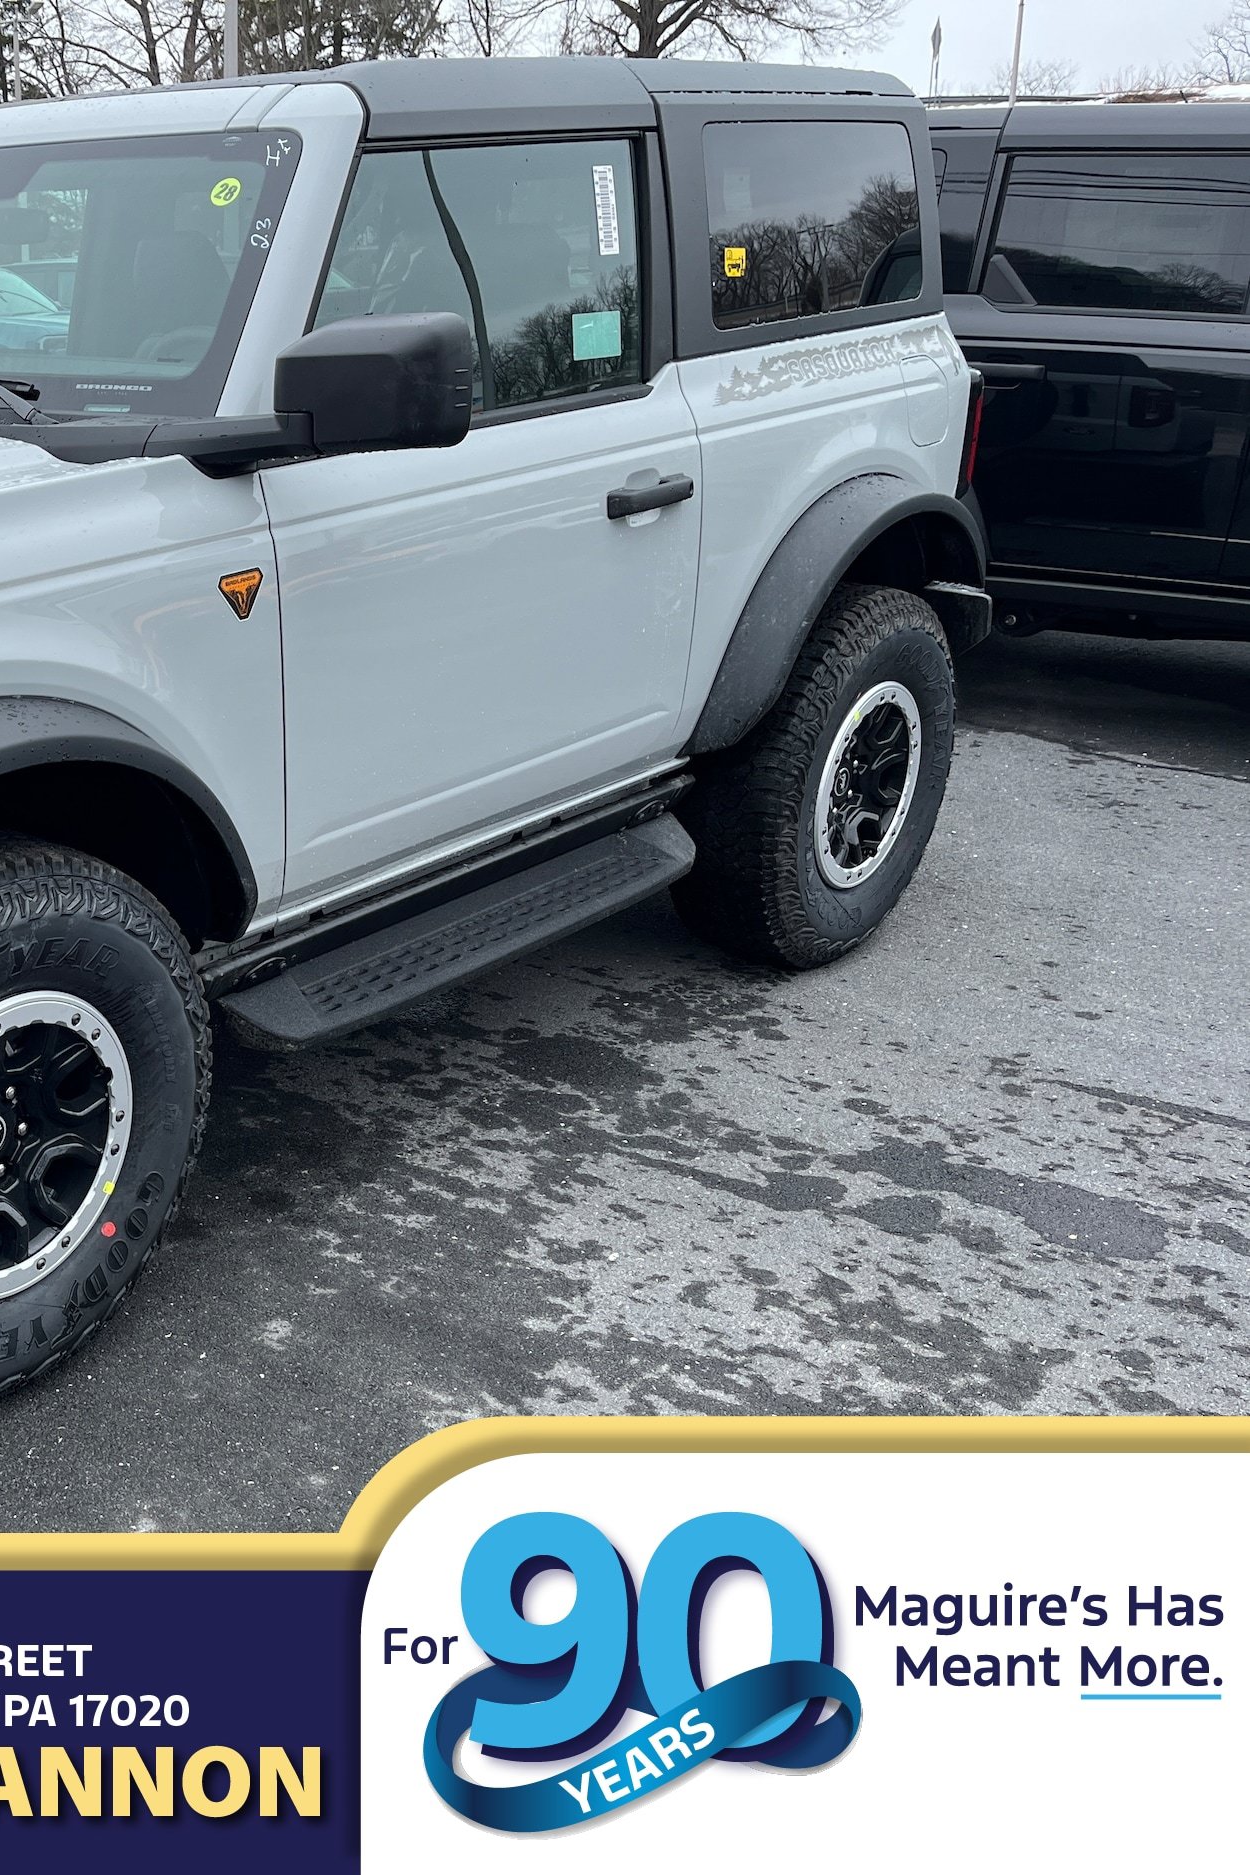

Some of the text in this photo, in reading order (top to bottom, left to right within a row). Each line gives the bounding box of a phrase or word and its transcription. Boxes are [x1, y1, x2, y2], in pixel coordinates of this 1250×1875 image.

[214, 183, 238, 202] 28
[787, 337, 898, 386] SASQUATCH
[75, 383, 153, 392] BRONCO
